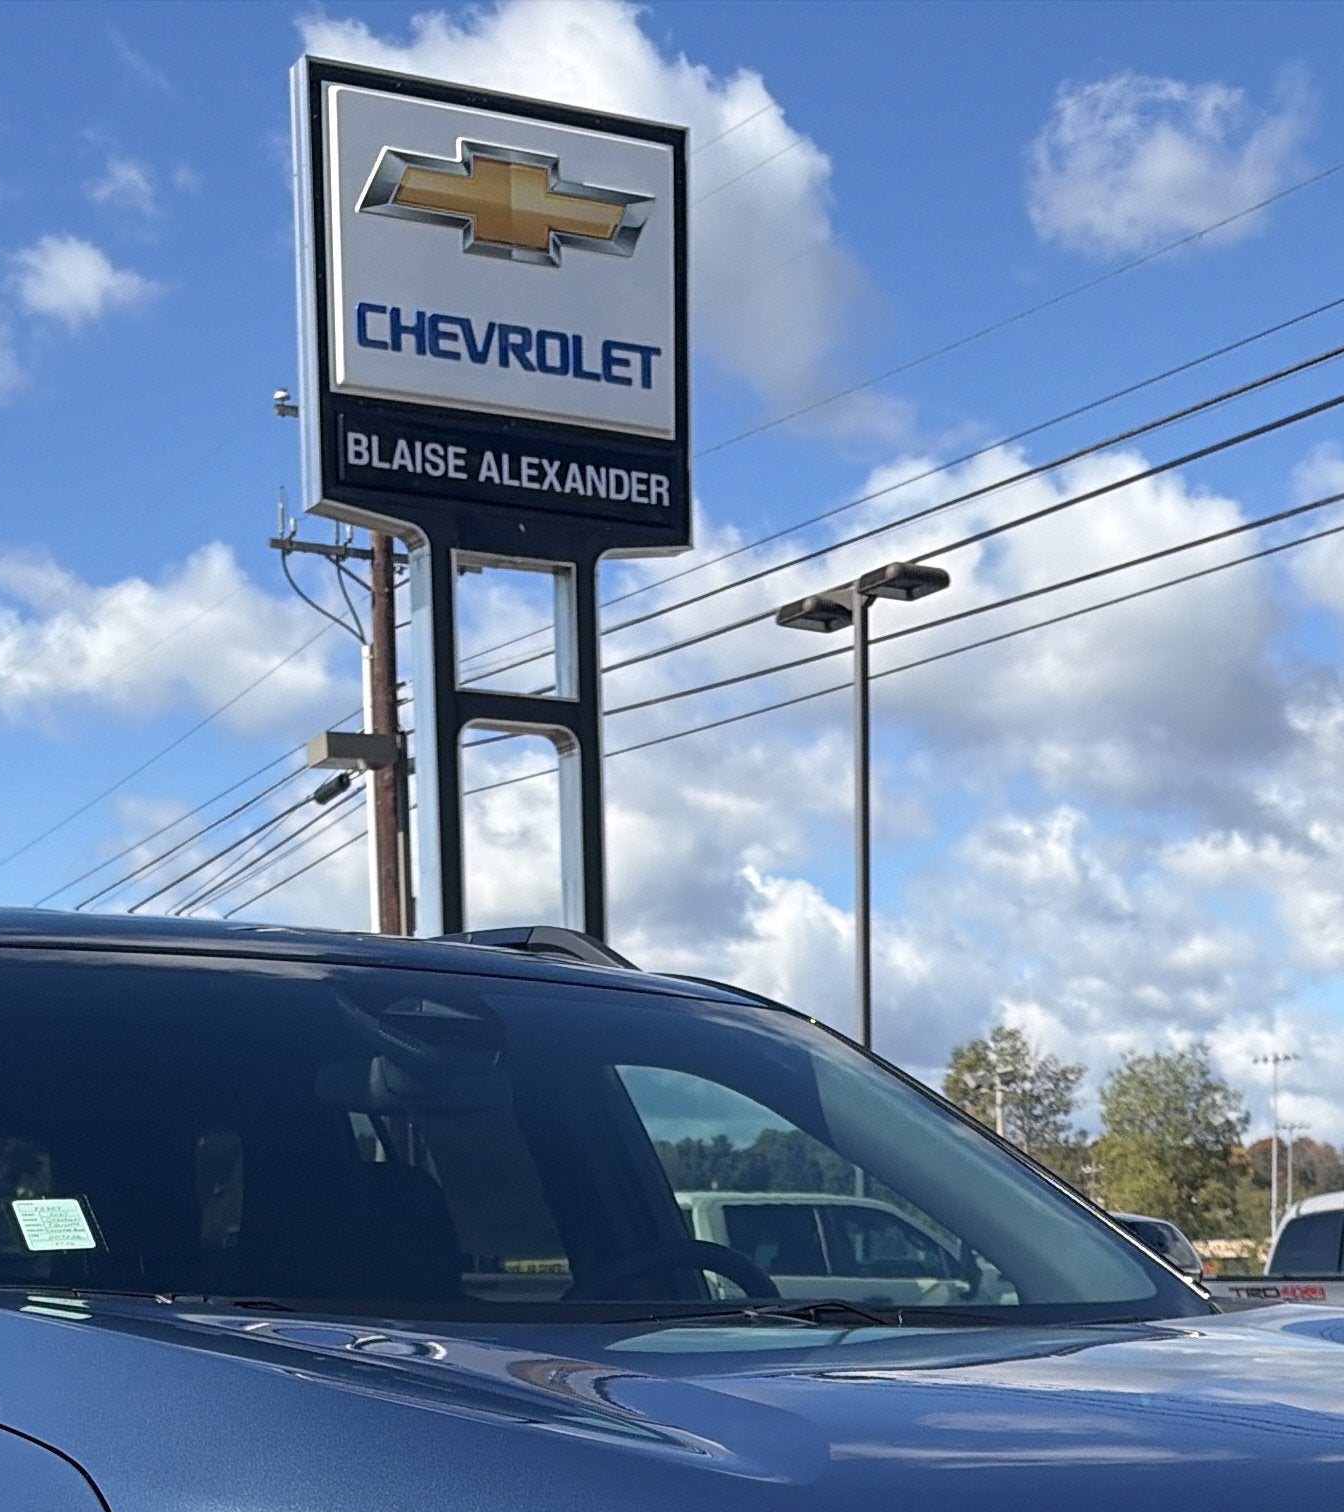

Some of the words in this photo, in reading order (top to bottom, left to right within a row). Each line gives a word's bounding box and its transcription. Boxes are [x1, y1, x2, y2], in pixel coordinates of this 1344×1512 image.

[356, 302, 662, 389] CHEVROLET
[346, 431, 468, 480] BLAISE
[478, 450, 670, 507] ALEXANDER
